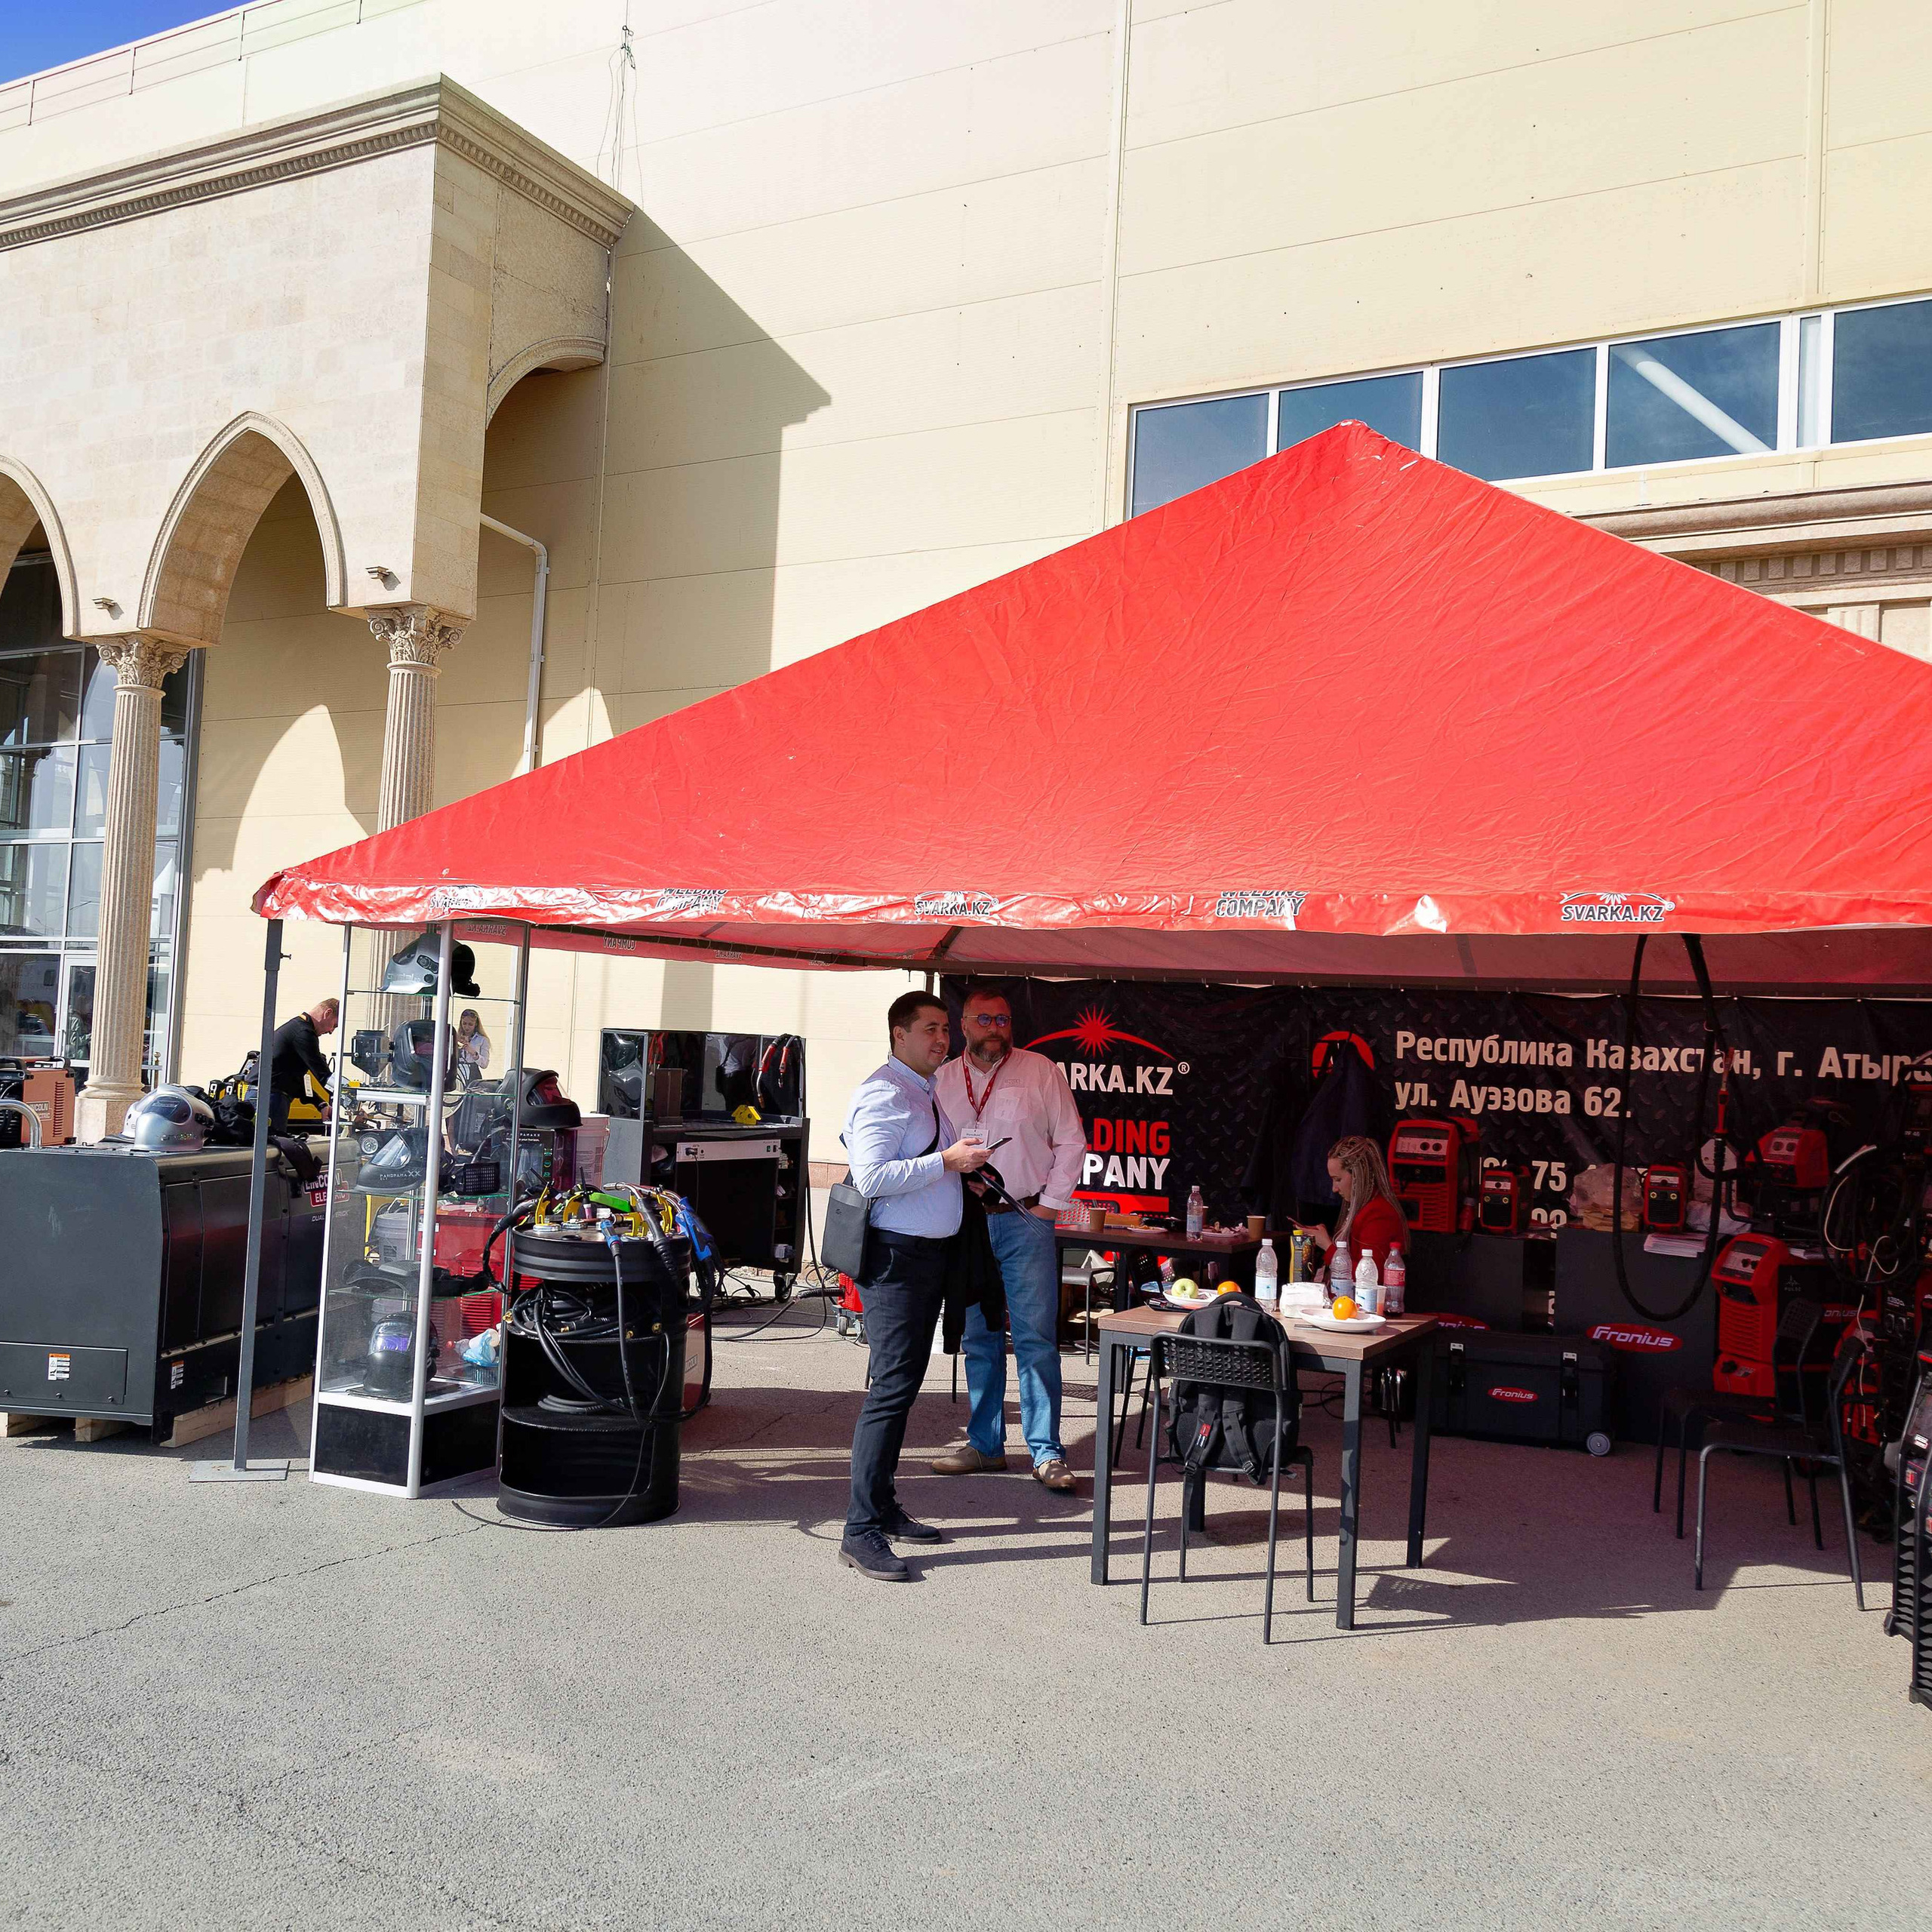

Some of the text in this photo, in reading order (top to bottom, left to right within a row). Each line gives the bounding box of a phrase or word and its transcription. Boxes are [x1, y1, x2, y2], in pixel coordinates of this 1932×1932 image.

[1562, 905, 1665, 921] SVARKA.KZ
[1396, 1031, 1573, 1068] Республика
[1777, 1051, 1803, 1077] г.
[1395, 1081, 1438, 1110] ул.
[1449, 1079, 1571, 1115] Ауэзова
[1087, 1118, 1170, 1155] DING
[1079, 1153, 1171, 1190] PANY
[1531, 1161, 1567, 1192] 75
[1592, 1325, 1675, 1347] Fronius
[1491, 1388, 1534, 1400] Fronius
